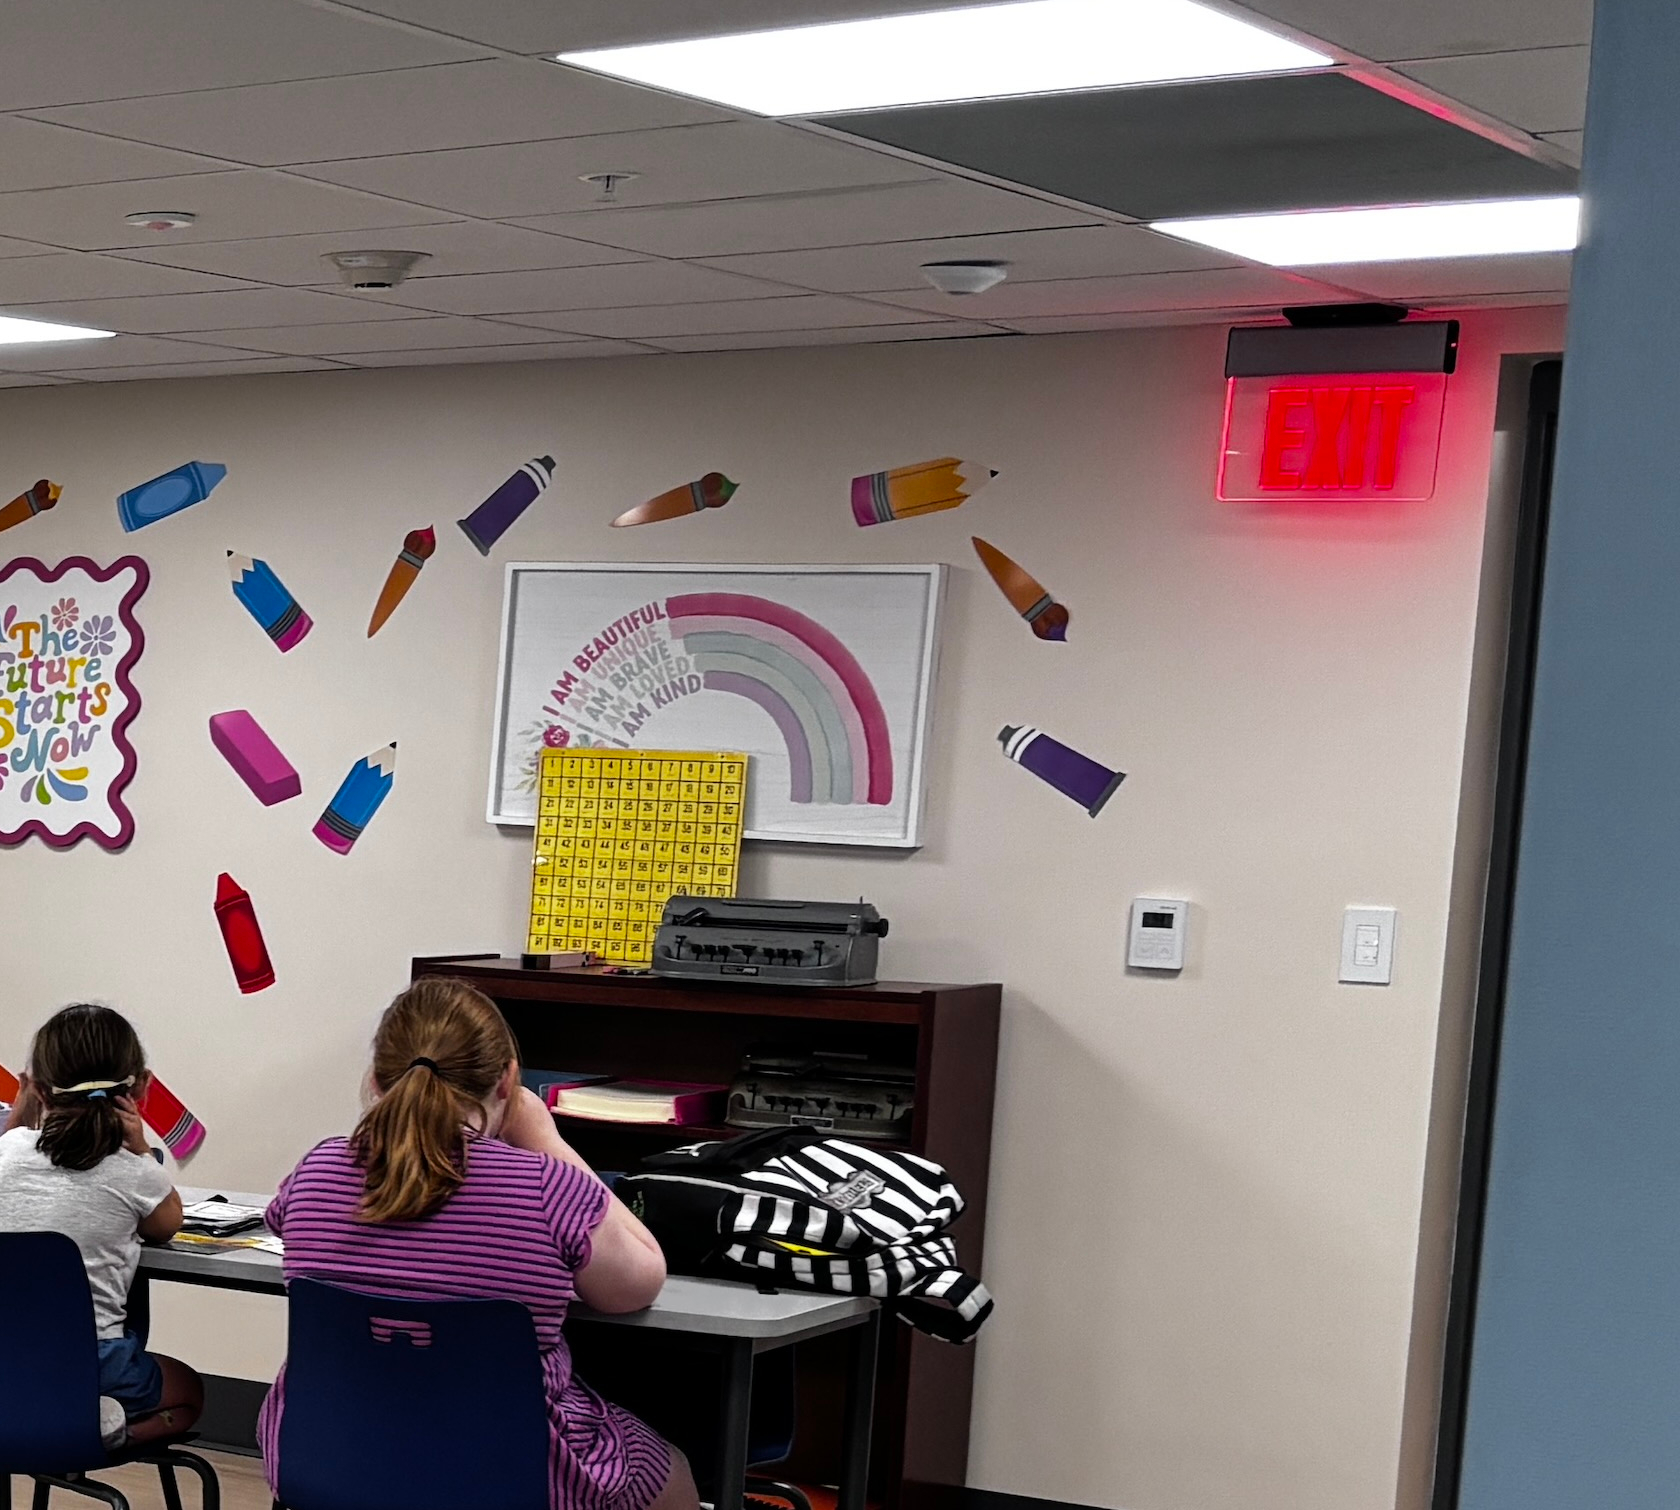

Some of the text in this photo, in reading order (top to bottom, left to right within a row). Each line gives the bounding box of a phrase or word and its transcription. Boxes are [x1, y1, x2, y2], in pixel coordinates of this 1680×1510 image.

[1259, 384, 1416, 490] EXIT
[8, 614, 80, 659] The
[542, 601, 666, 716] I AM BEAUTIFUL
[568, 679, 596, 714] AM
[590, 624, 662, 681] UNIQUE
[585, 687, 614, 722] AM
[609, 640, 671, 691] BRAVE
[603, 695, 633, 731] AM
[629, 656, 690, 699] LOVED
[621, 702, 652, 738] AM
[650, 674, 703, 709] KIND
[10, 720, 101, 773] Now
